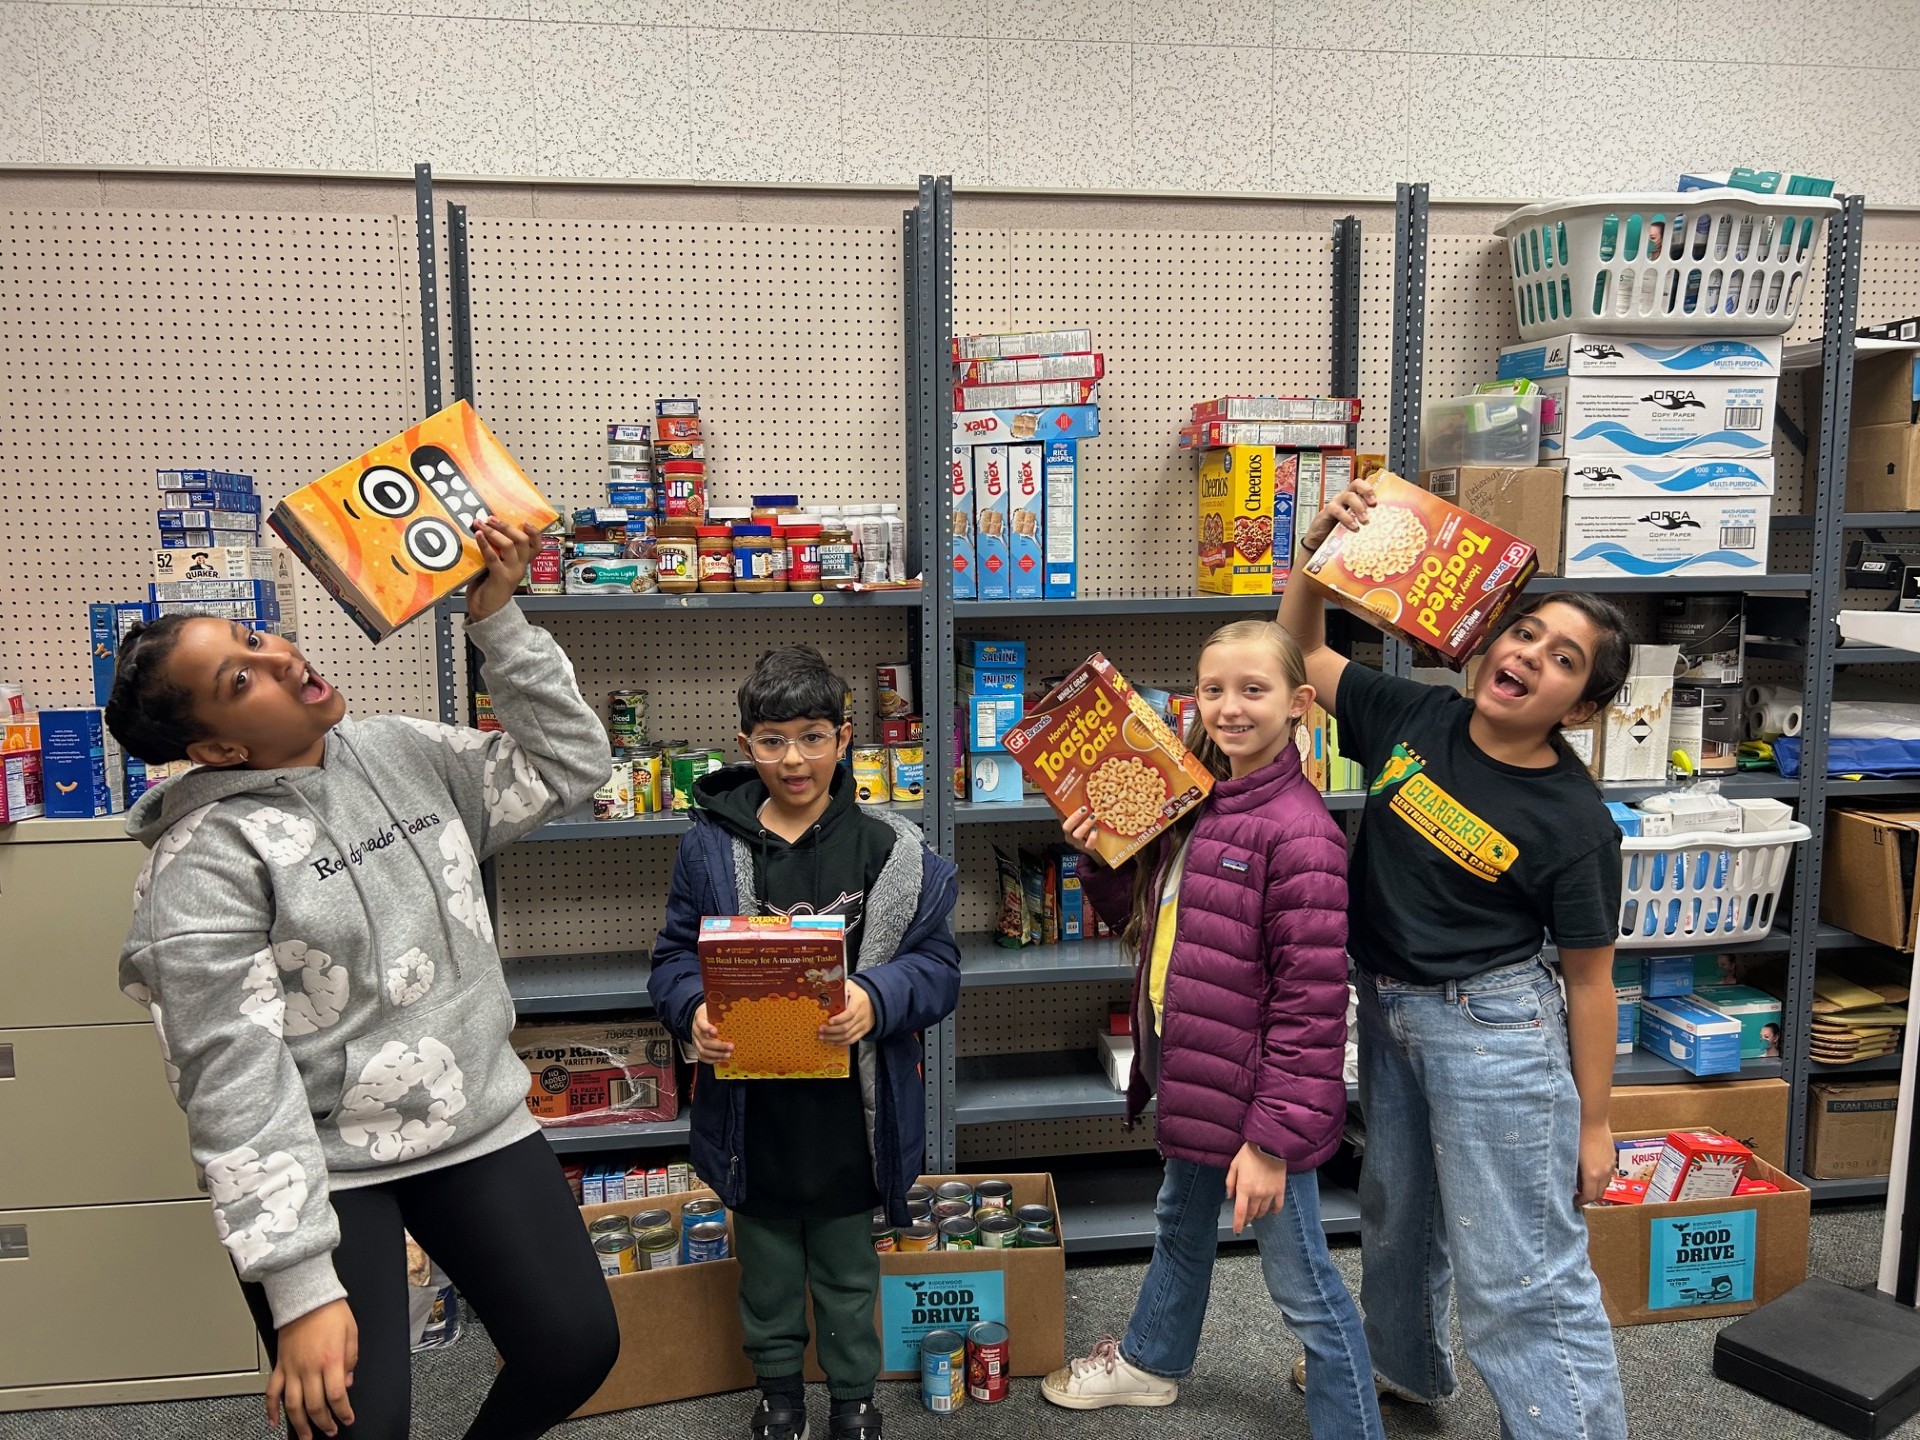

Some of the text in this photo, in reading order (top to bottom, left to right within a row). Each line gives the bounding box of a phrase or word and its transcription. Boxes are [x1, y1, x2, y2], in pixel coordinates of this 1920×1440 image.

[1653, 390, 1695, 400] ORCA
[964, 417, 998, 432] Chex
[952, 461, 966, 495] Chex
[988, 461, 1002, 496] Chex
[1022, 461, 1035, 496] Chex
[1202, 474, 1228, 498] Cheerios
[1245, 454, 1262, 512] Cheerios
[668, 482, 693, 498] Jif
[1650, 511, 1690, 520] ORCA
[157, 554, 173, 568] 52
[660, 555, 683, 570] Jif
[1507, 546, 1525, 564] GF
[186, 570, 219, 579] QUAKER
[1406, 556, 1442, 607] Oats
[1416, 528, 1492, 637] Toasted
[1482, 562, 1508, 590] Brands
[1450, 564, 1483, 611] Honey Nut
[1450, 609, 1482, 648] WHOLE GRAIN
[981, 653, 1017, 662] SALTINE
[982, 675, 1017, 683] SALTINE
[1057, 671, 1089, 702] WHOLE GRAIN
[1025, 715, 1051, 738] Brands
[1048, 705, 1082, 744] Honey Nut
[1010, 733, 1025, 749] GF
[1034, 686, 1113, 783] Toasted
[1080, 721, 1118, 766] Oats
[1401, 741, 1427, 766] KRHS
[1405, 779, 1486, 847] CHARGERS
[392, 813, 440, 839] Tears
[1391, 794, 1501, 876] KENTRIDGE HOOPS CAMP
[748, 915, 790, 925] Cheerios
[734, 957, 758, 965] Honey
[1689, 1035, 1694, 1043] 3
[536, 1048, 566, 1061] Top
[653, 1043, 668, 1057] 48
[564, 1057, 611, 1066] VARIETY PAC
[544, 1075, 567, 1085] ADDED
[526, 1096, 540, 1107] EN
[570, 1094, 605, 1105] BEEF
[1834, 1102, 1860, 1110] EXAM
[1864, 1101, 1889, 1109] TABLE
[1631, 1153, 1659, 1165] KRUST
[1681, 1229, 1731, 1247] FOOD
[1676, 1245, 1734, 1264] DRIVE
[916, 1290, 974, 1307] FOOD
[911, 1306, 980, 1324] DRIVE
